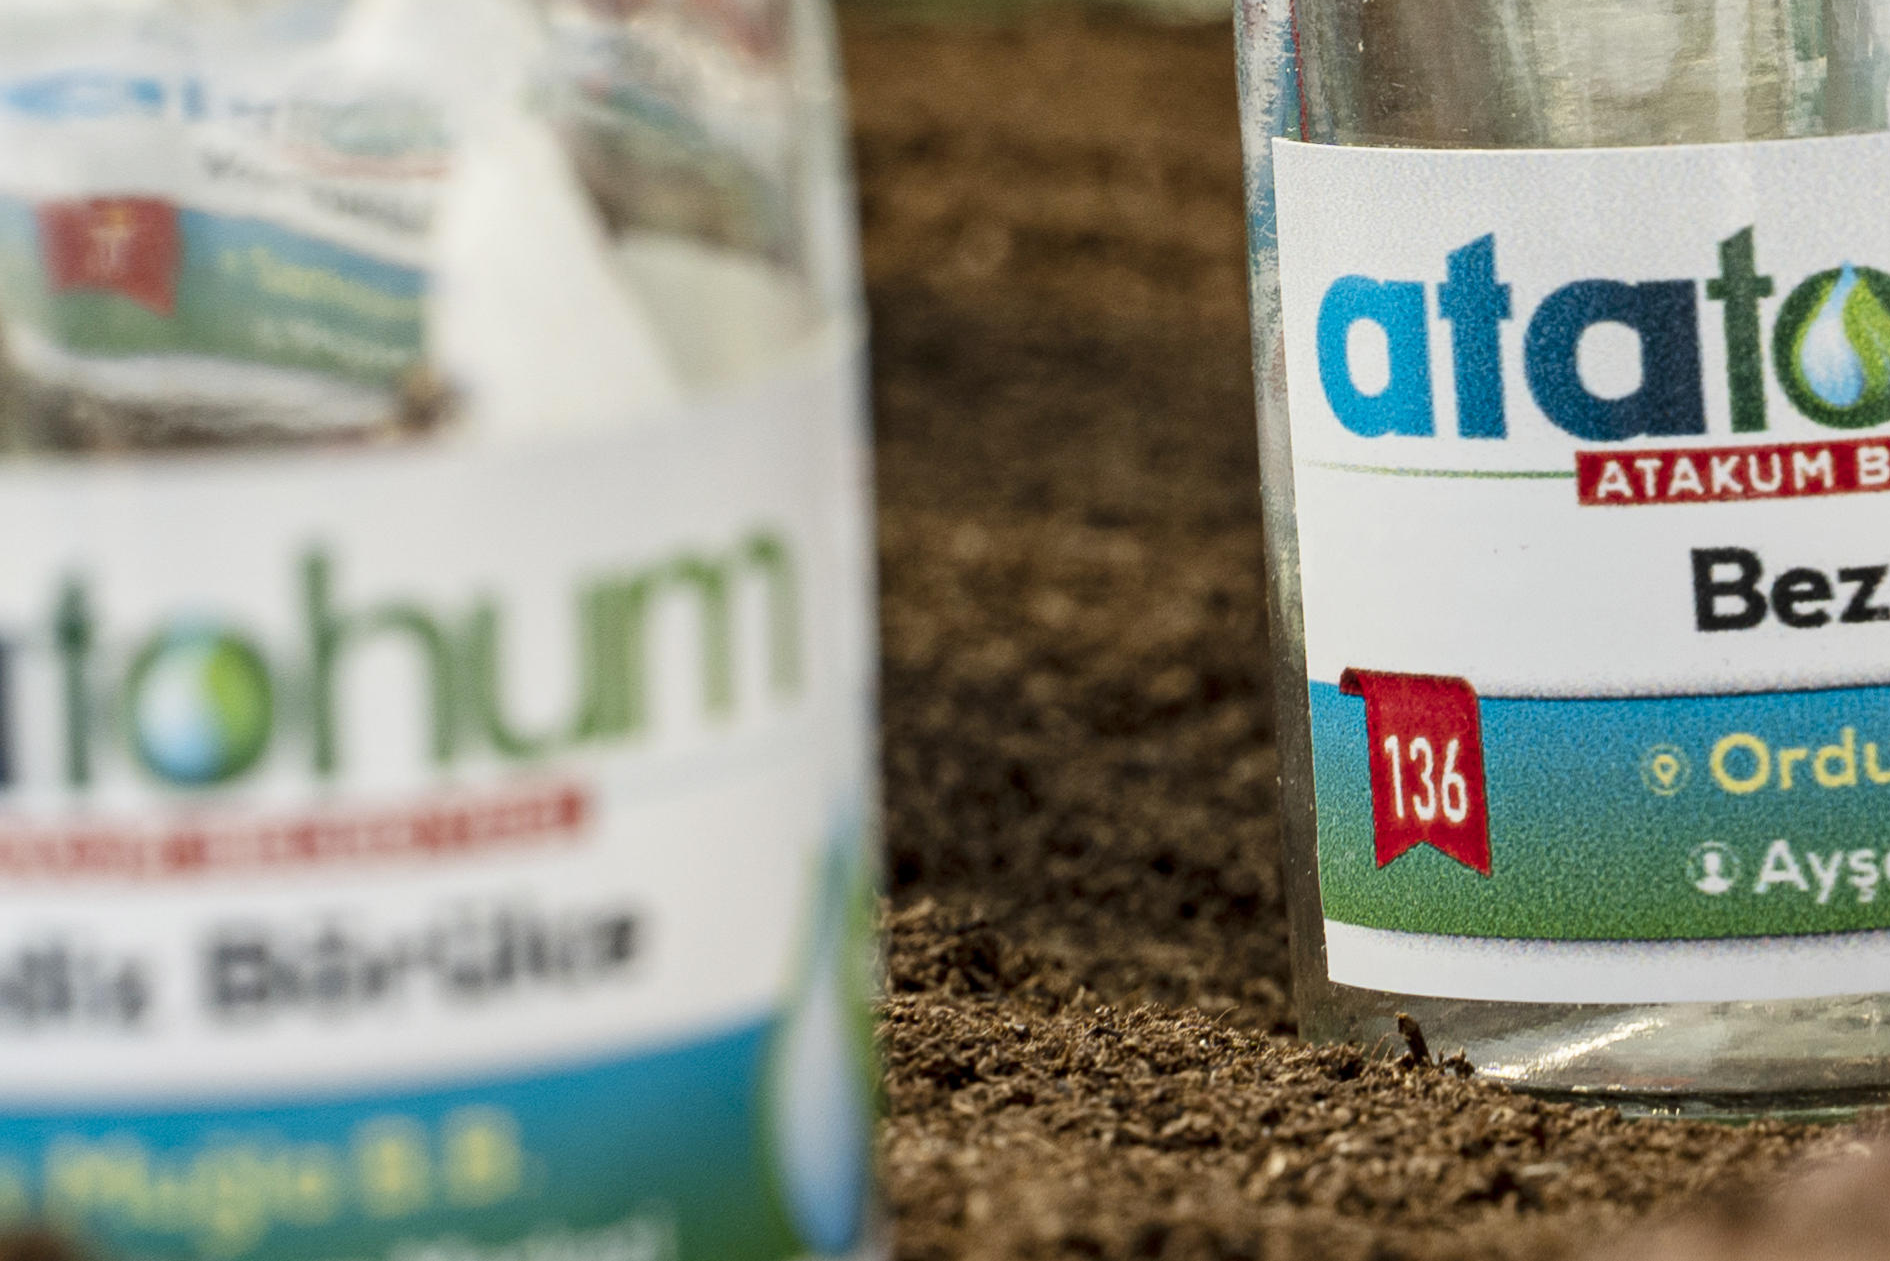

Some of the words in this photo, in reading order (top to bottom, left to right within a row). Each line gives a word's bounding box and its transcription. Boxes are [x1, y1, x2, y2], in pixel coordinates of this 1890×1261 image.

[1595, 449, 1835, 502] ATAKUM
[0, 538, 798, 788] tohum
[1384, 735, 1470, 825] 136
